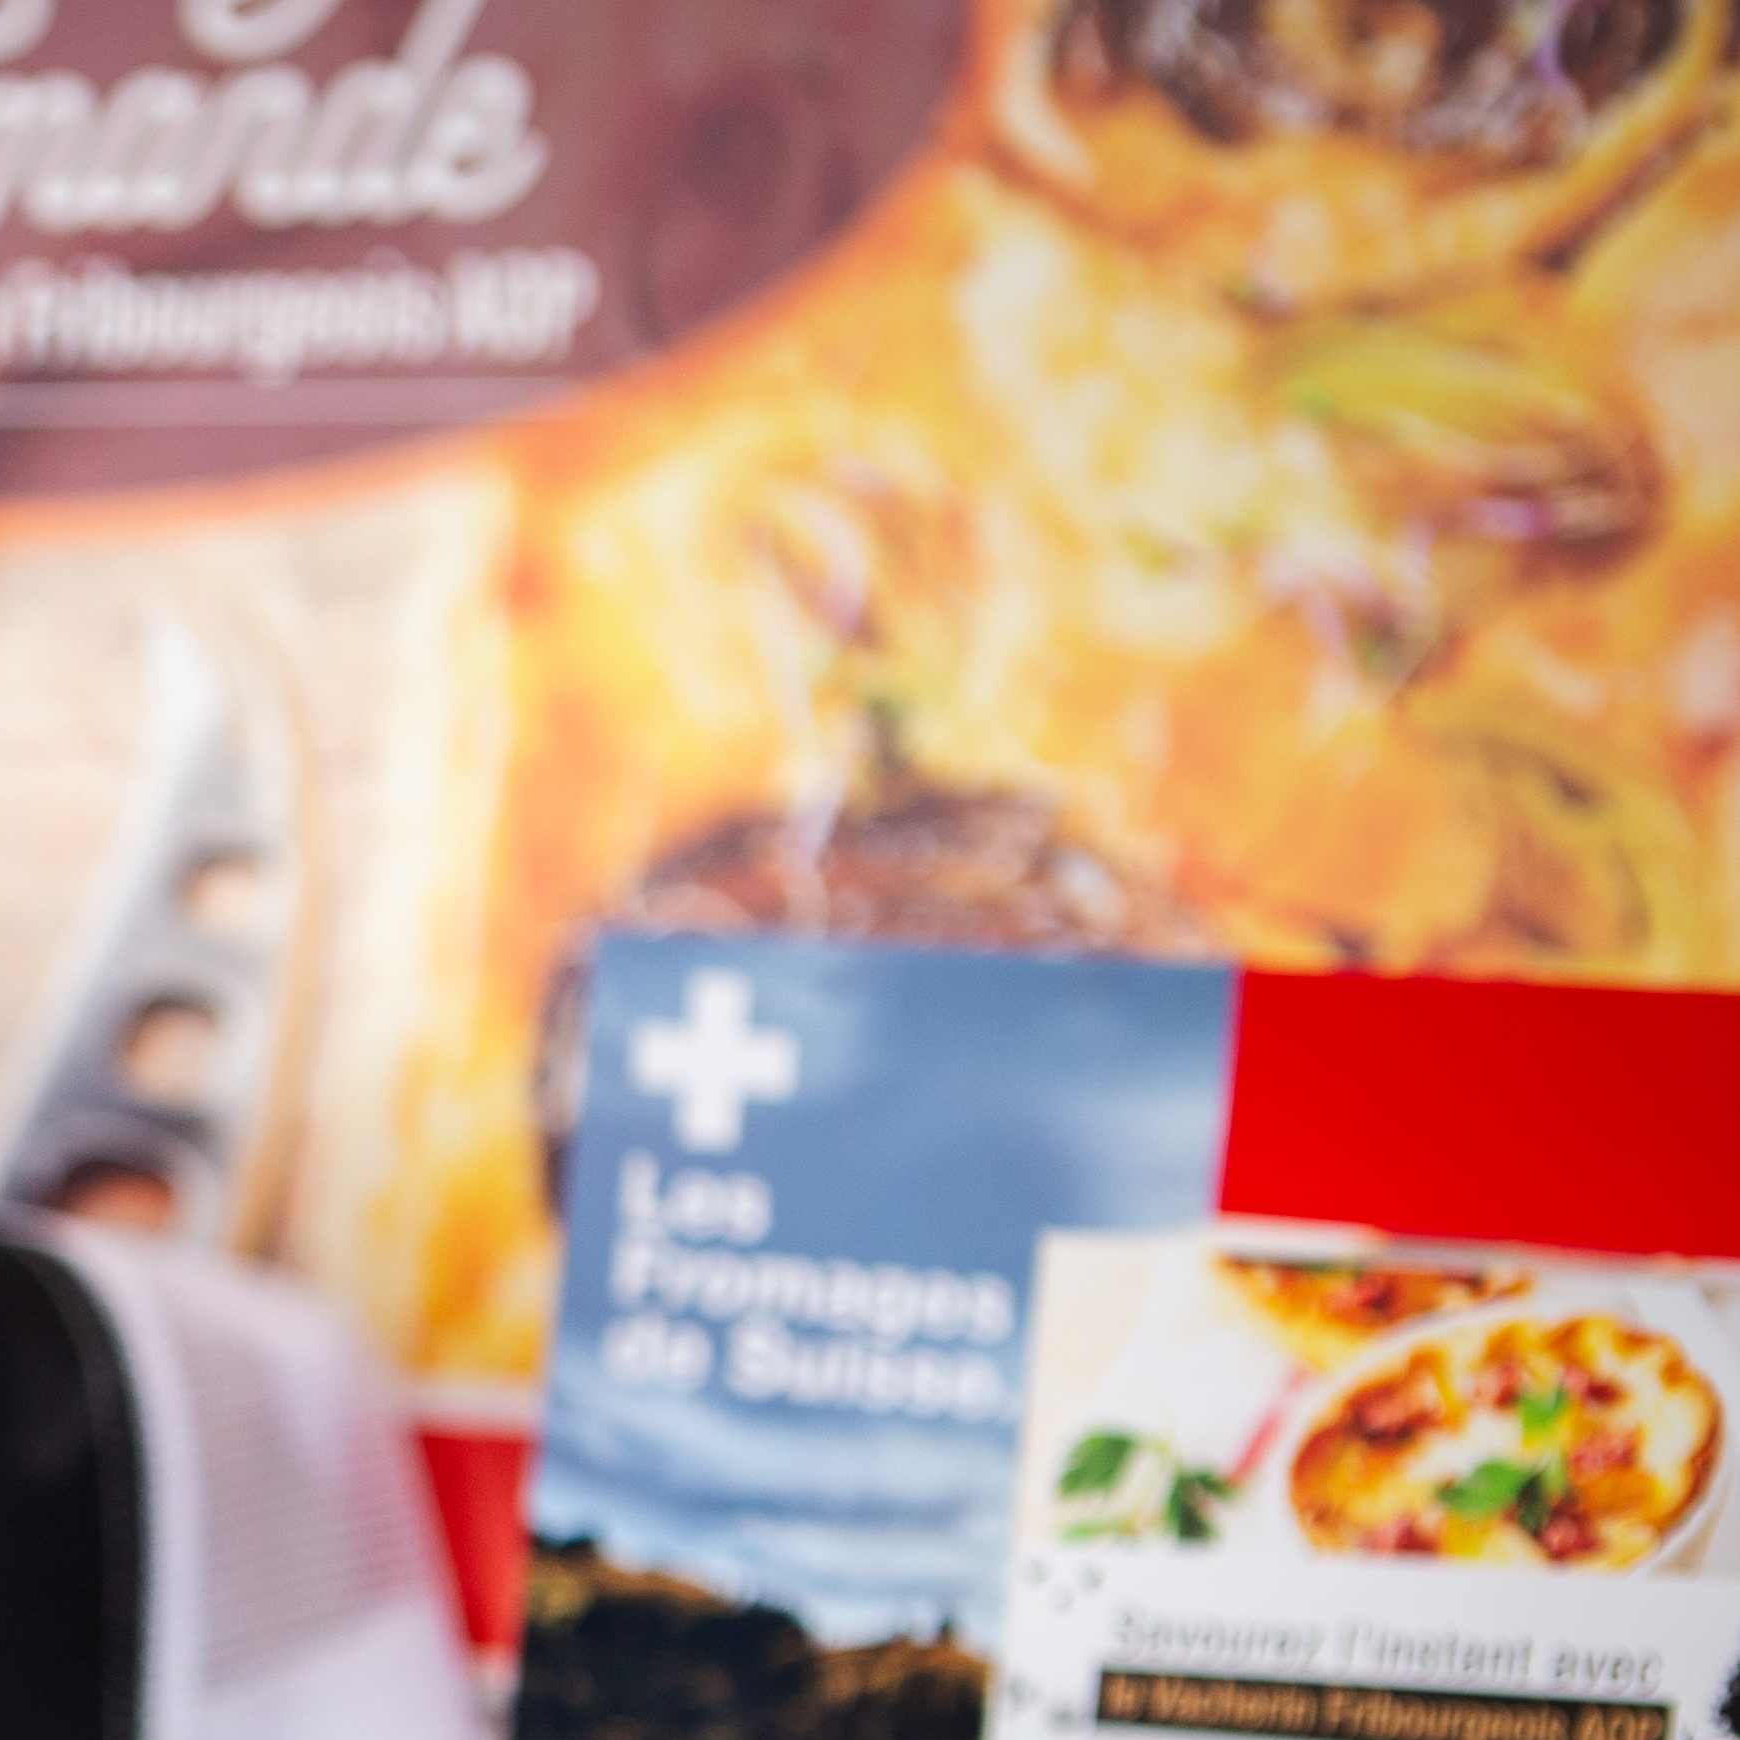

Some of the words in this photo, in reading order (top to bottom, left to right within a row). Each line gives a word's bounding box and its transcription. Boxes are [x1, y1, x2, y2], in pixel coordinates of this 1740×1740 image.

[2, 250, 445, 387] Fribourgeois
[619, 1148, 773, 1246] Les
[611, 1232, 1015, 1350] Fromages
[599, 1310, 713, 1392] de
[1117, 1608, 1323, 1668] Savourez
[1551, 1642, 1667, 1694] avec
[1150, 1673, 1319, 1732] Vacherin
